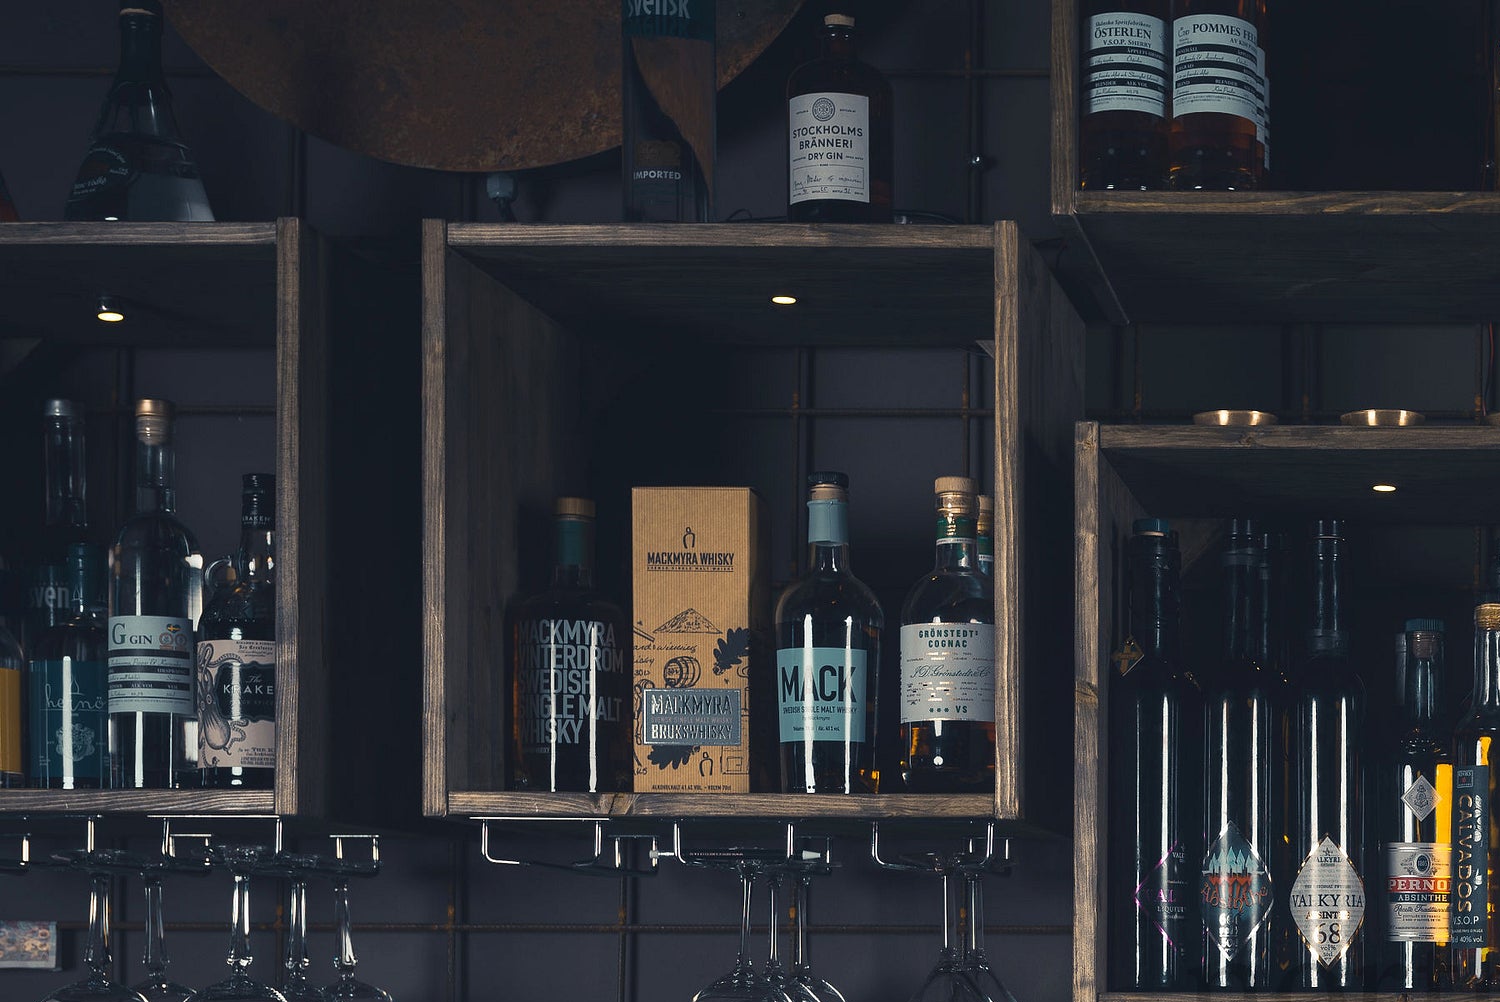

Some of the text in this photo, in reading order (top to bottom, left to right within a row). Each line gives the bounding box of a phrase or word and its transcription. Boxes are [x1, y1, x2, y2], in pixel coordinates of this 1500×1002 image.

[1094, 26, 1152, 40] ÖSTERLEN
[1192, 23, 1241, 37] POMMES
[793, 125, 864, 140] STOCKHOLMS
[799, 136, 853, 150] BRÄNNERI
[808, 152, 824, 161] DRY
[825, 152, 843, 161] GIN
[633, 170, 682, 181] IMPORTED
[647, 552, 735, 566] MACKMYRA WHISKY
[111, 622, 153, 645] G GIN
[519, 619, 617, 647] MACKMYRA
[927, 639, 969, 648] COGNAC
[578, 694, 622, 721] MALT
[650, 694, 734, 715] MACKMYRA
[820, 706, 835, 714] MALT
[955, 704, 968, 714] VS
[519, 718, 584, 745] WHISKY
[650, 724, 734, 740] BRUKSWHISKY
[1457, 794, 1473, 912] CALVADOS
[1388, 879, 1452, 891] PERNO
[1398, 893, 1448, 902] ABSINTHE
[1315, 921, 1342, 945] 68
